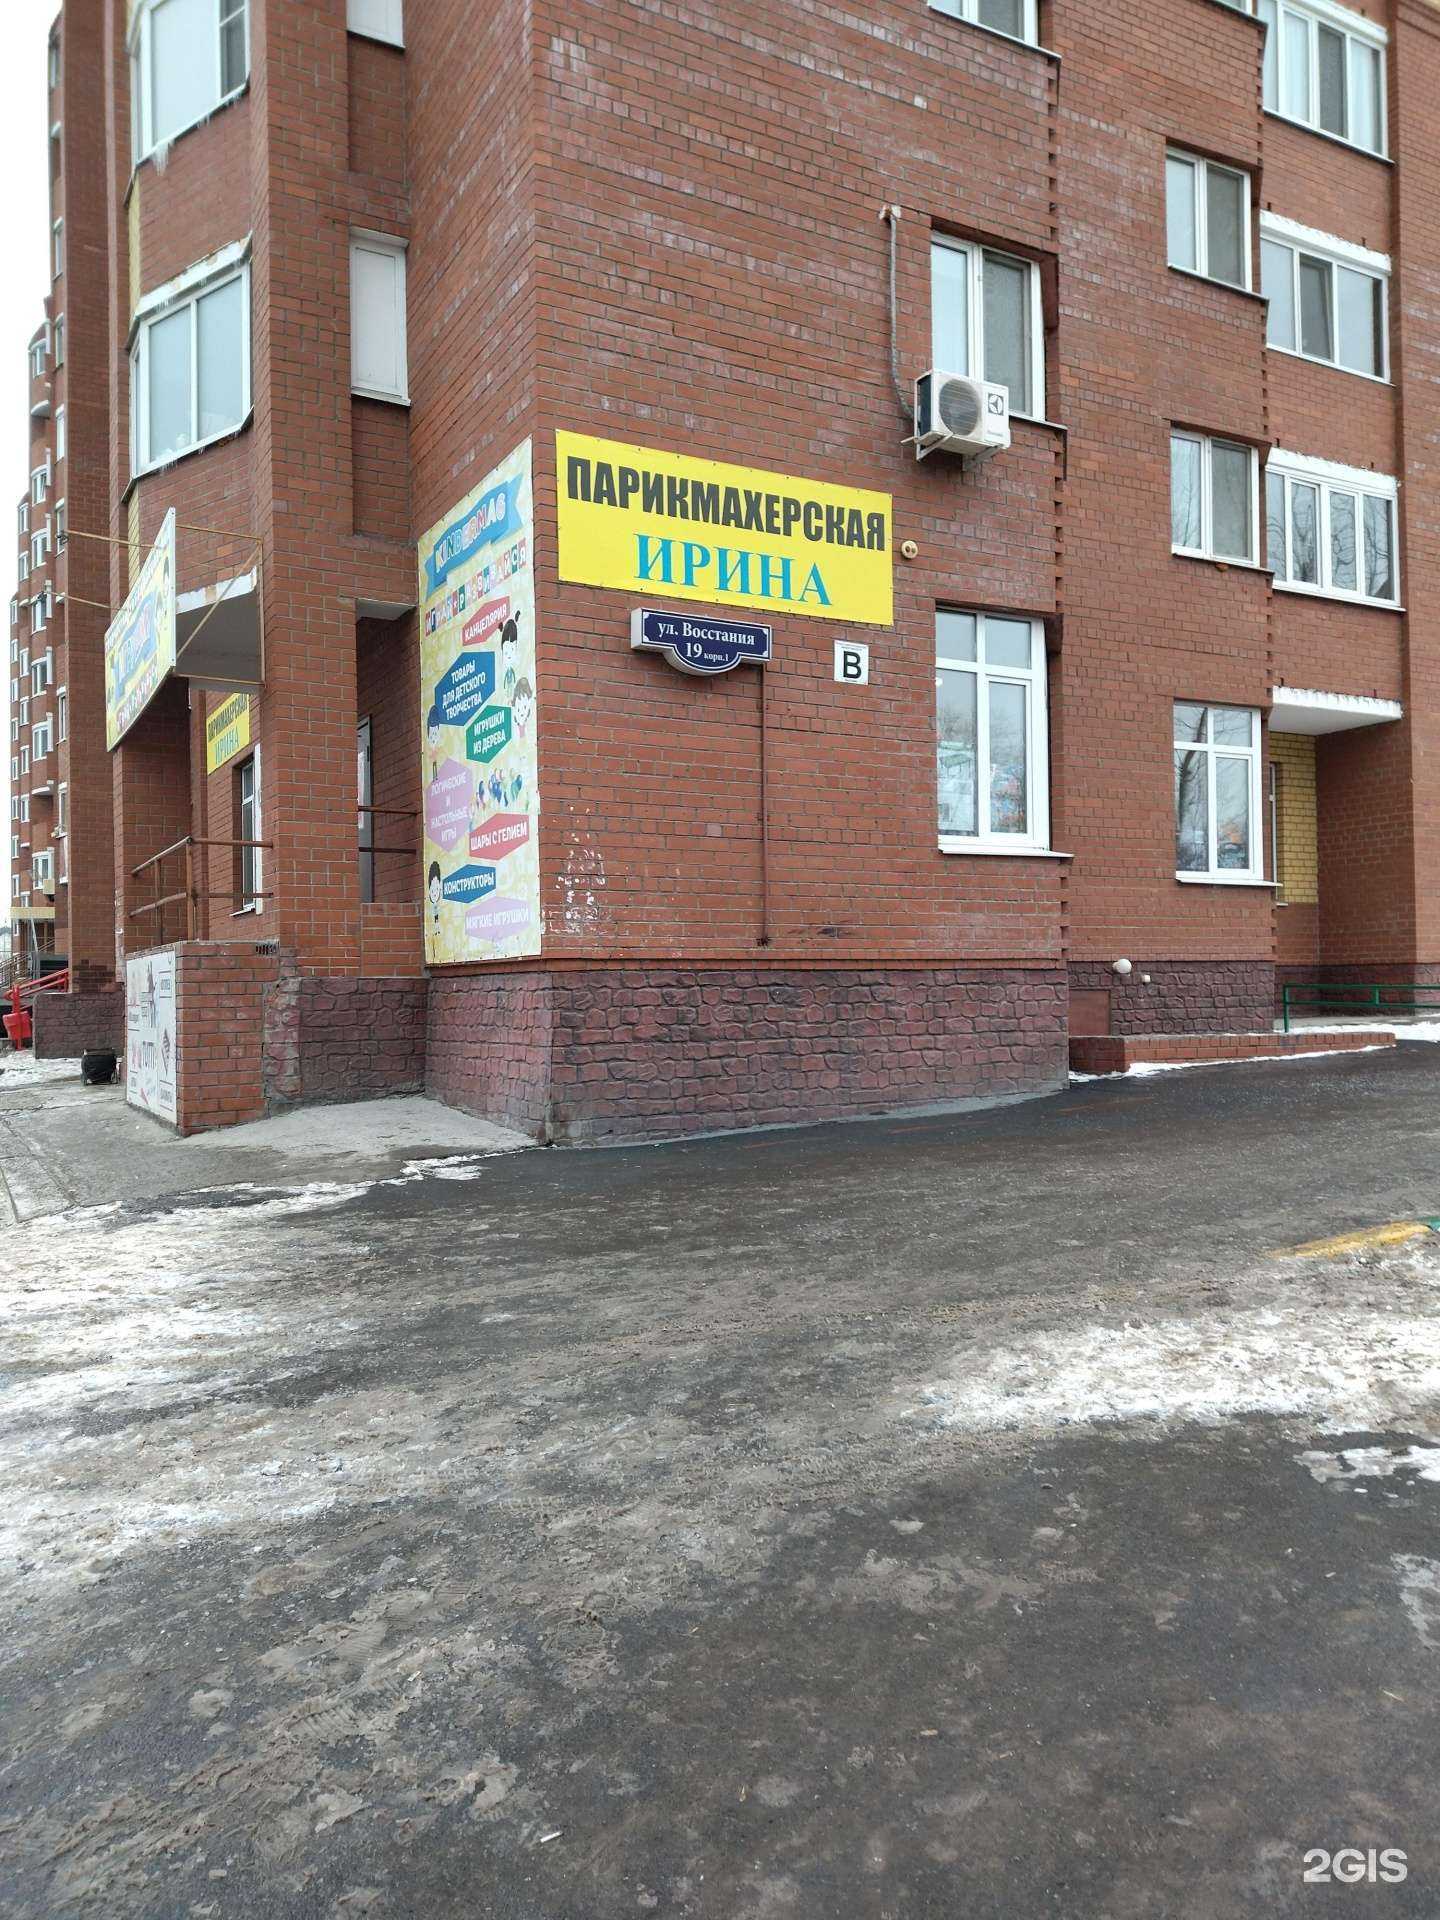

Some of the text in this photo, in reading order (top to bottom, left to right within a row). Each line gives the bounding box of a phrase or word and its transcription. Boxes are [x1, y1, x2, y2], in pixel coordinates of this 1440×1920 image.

[567, 456, 885, 551] ПАРИКМАХЕРСКАЯ
[633, 533, 833, 606] ИРИНА
[464, 603, 507, 641] КАНЦЕЛЯРИЯ
[657, 622, 755, 645] ул. Восстания
[686, 642, 702, 658] 19
[451, 660, 476, 684] ТОВАРЫ
[442, 672, 486, 708] ДЛЯ ДЕТСКОГО
[445, 692, 483, 720] ТВОРЧЕСТВА
[474, 710, 504, 737] ИГРУШКИ
[473, 731, 506, 754] ИЗ ДЕРЕВА
[441, 828, 457, 843] ИГРЫ
[470, 831, 491, 851] ШАРЫ
[497, 822, 527, 843] ГЕЛИЕМ
[443, 871, 495, 895] КОНСТРУКТОРЫ
[466, 908, 529, 931] МЯГКИЕ ИГРУШКИ
